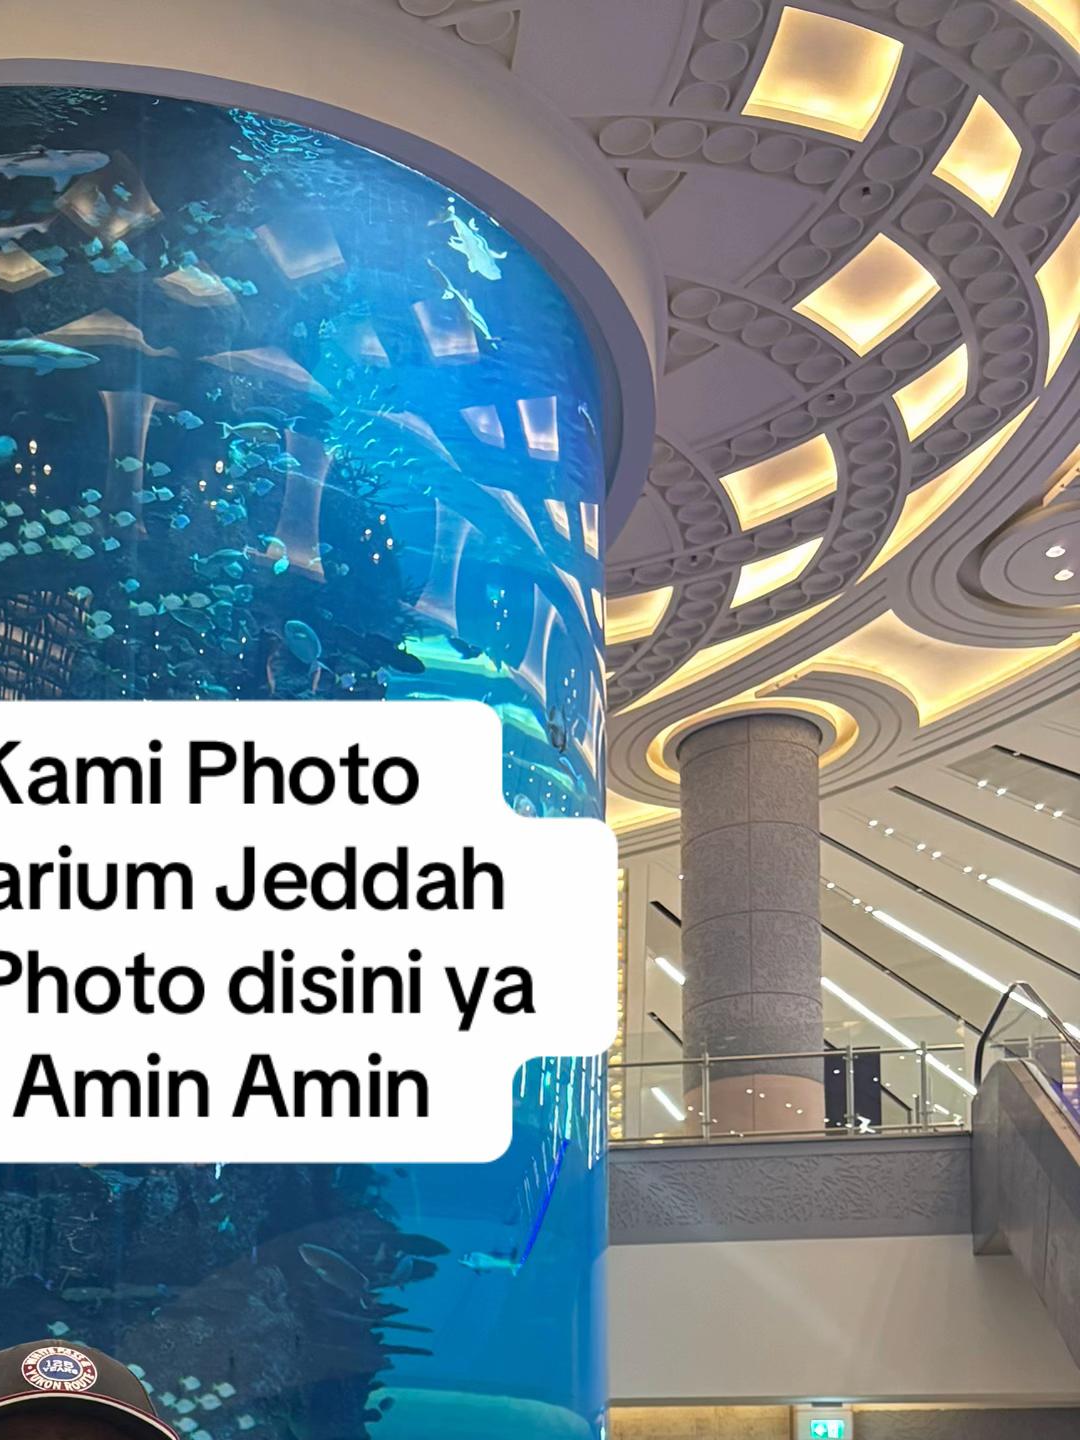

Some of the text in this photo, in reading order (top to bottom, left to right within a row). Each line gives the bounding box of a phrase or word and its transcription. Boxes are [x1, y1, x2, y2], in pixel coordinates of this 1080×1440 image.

[42, 1367, 78, 1375] YEARS
[26, 1369, 95, 1391] YUKON ROUTE
